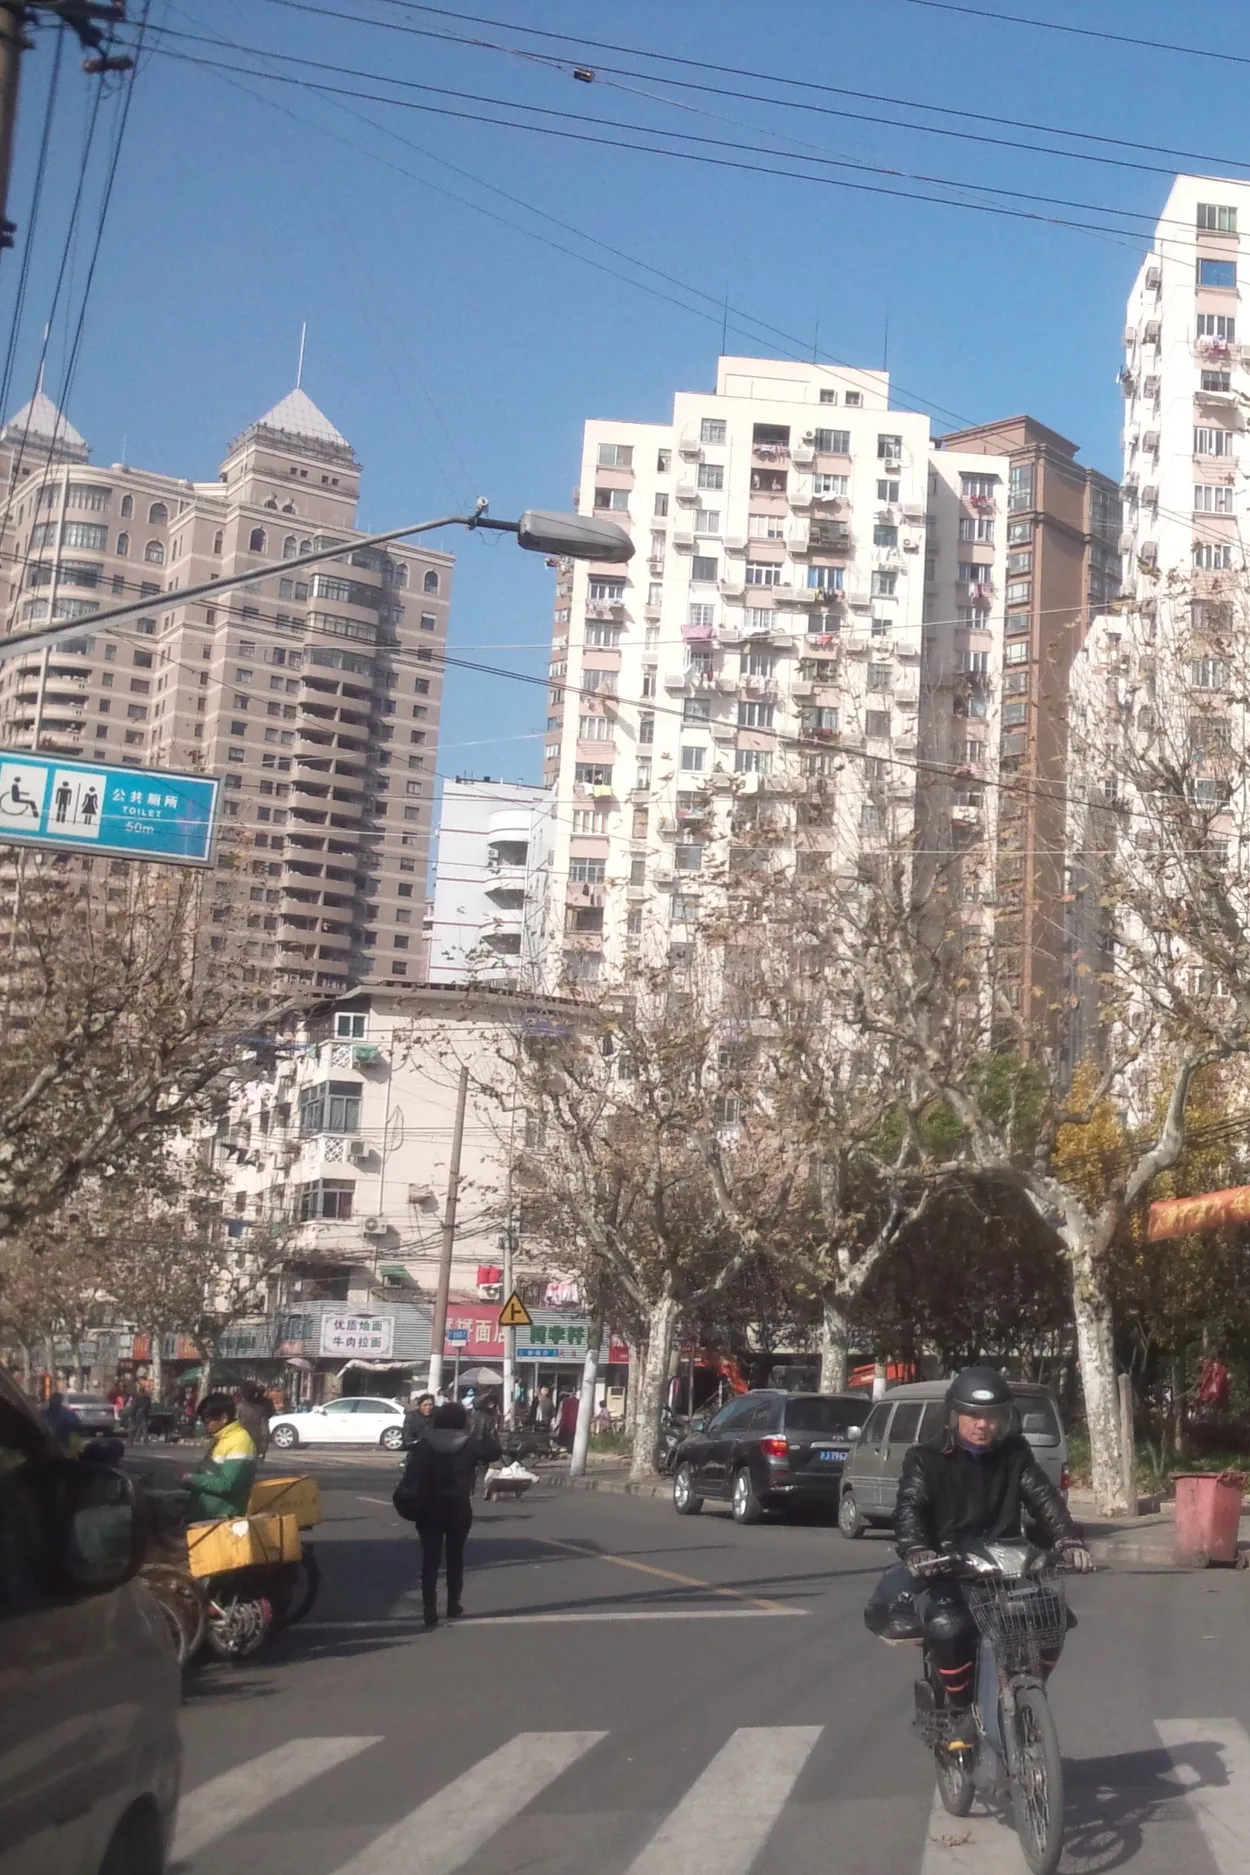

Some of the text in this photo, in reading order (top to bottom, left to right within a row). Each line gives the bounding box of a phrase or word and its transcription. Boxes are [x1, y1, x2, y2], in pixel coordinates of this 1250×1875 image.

[122, 805, 162, 818] TOILET
[126, 821, 154, 834] 50m
[332, 1336, 382, 1348] 牛肉拉面
